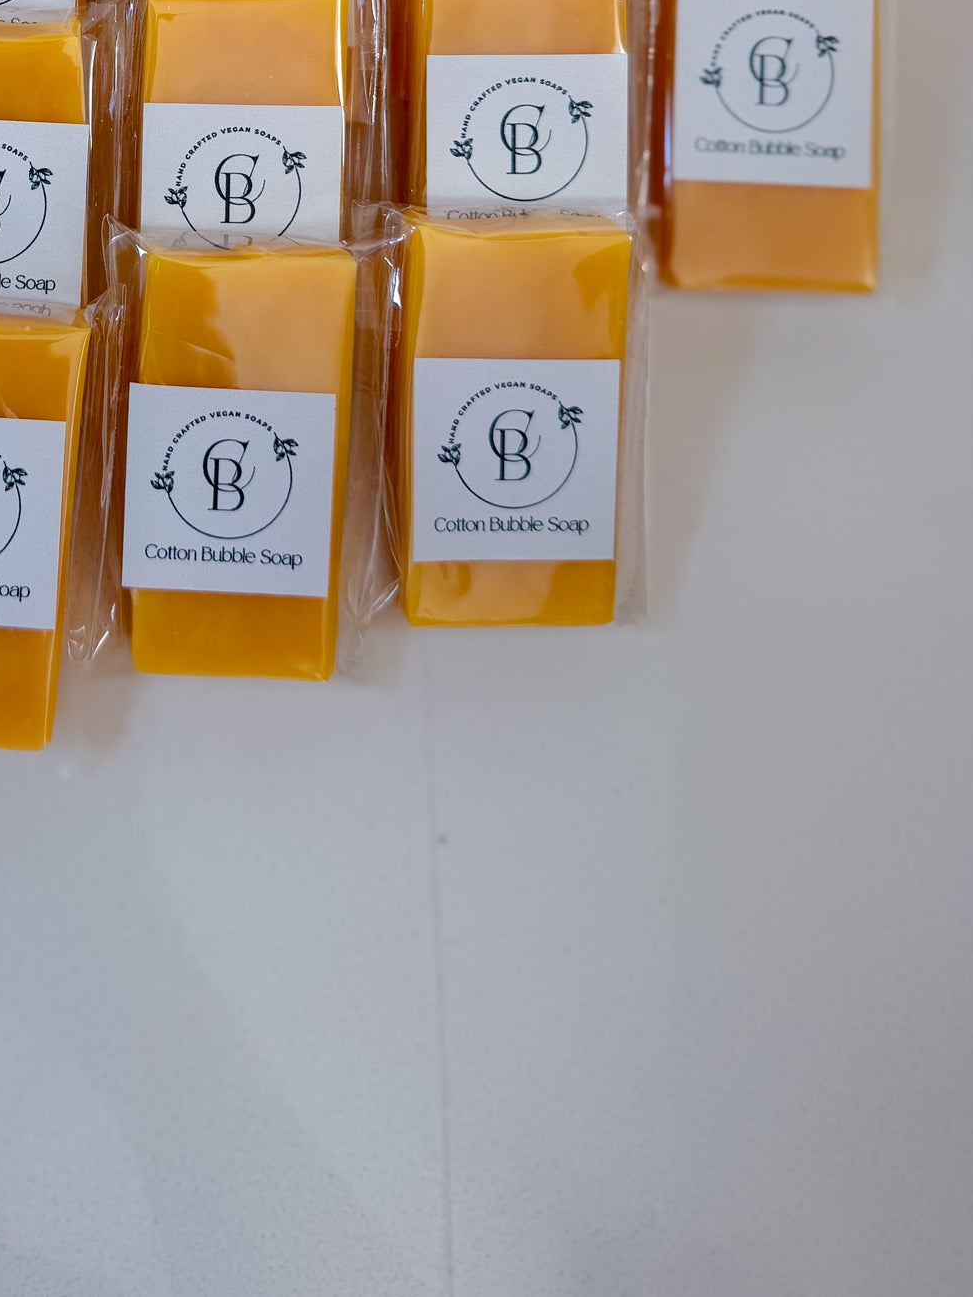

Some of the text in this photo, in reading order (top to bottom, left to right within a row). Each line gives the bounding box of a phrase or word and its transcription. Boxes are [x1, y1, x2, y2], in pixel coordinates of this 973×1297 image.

[0, 143, 29, 162] SOAPS
[175, 126, 282, 189] HAND CRAFTED VEGAN SOAPS
[695, 136, 846, 162] Cotton Bubble Soap
[15, 274, 57, 295] Soap
[162, 410, 273, 473] HAND CRAFTED VEGAN SOAPS
[433, 515, 591, 536] Cotton Bubble Soap
[144, 543, 304, 570] Cotton Bubble Soap
